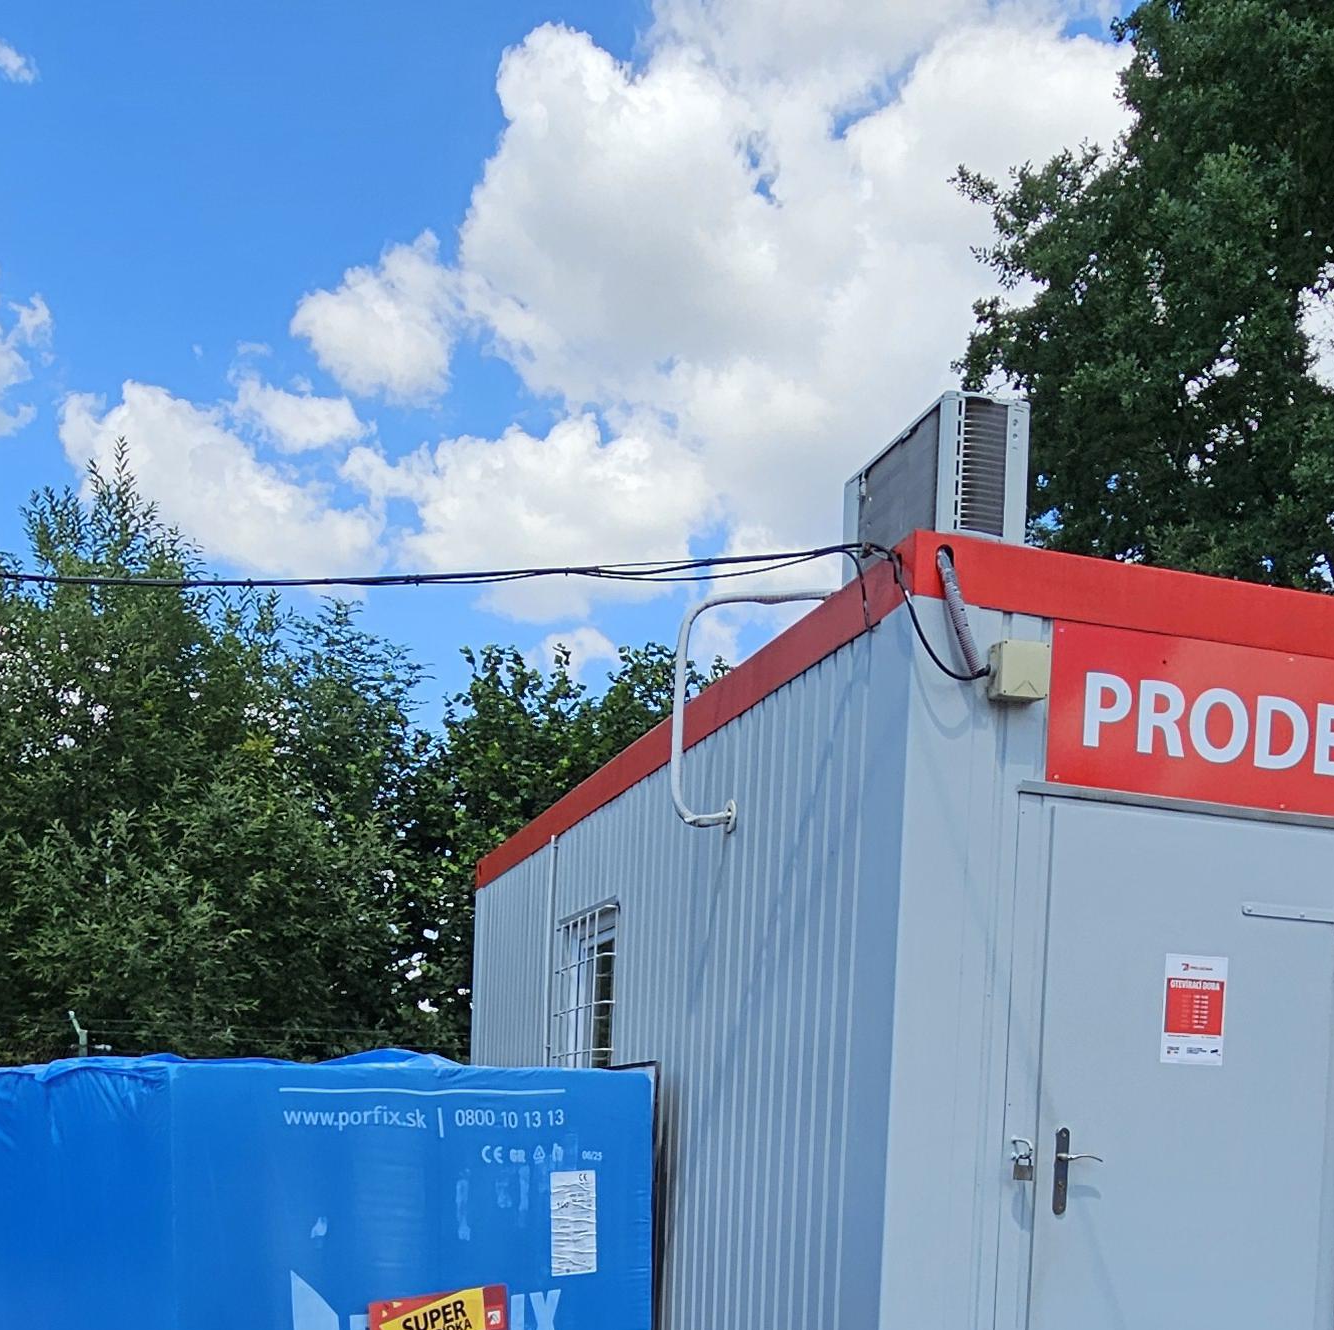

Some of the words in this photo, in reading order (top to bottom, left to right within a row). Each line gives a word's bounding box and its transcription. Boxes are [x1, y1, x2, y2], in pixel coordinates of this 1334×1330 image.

[283, 1105, 427, 1131] www.porfix.sk
[454, 1109, 496, 1128] 0800
[500, 1111, 517, 1129] 10
[524, 1110, 542, 1128] 13
[547, 1109, 564, 1127] 13
